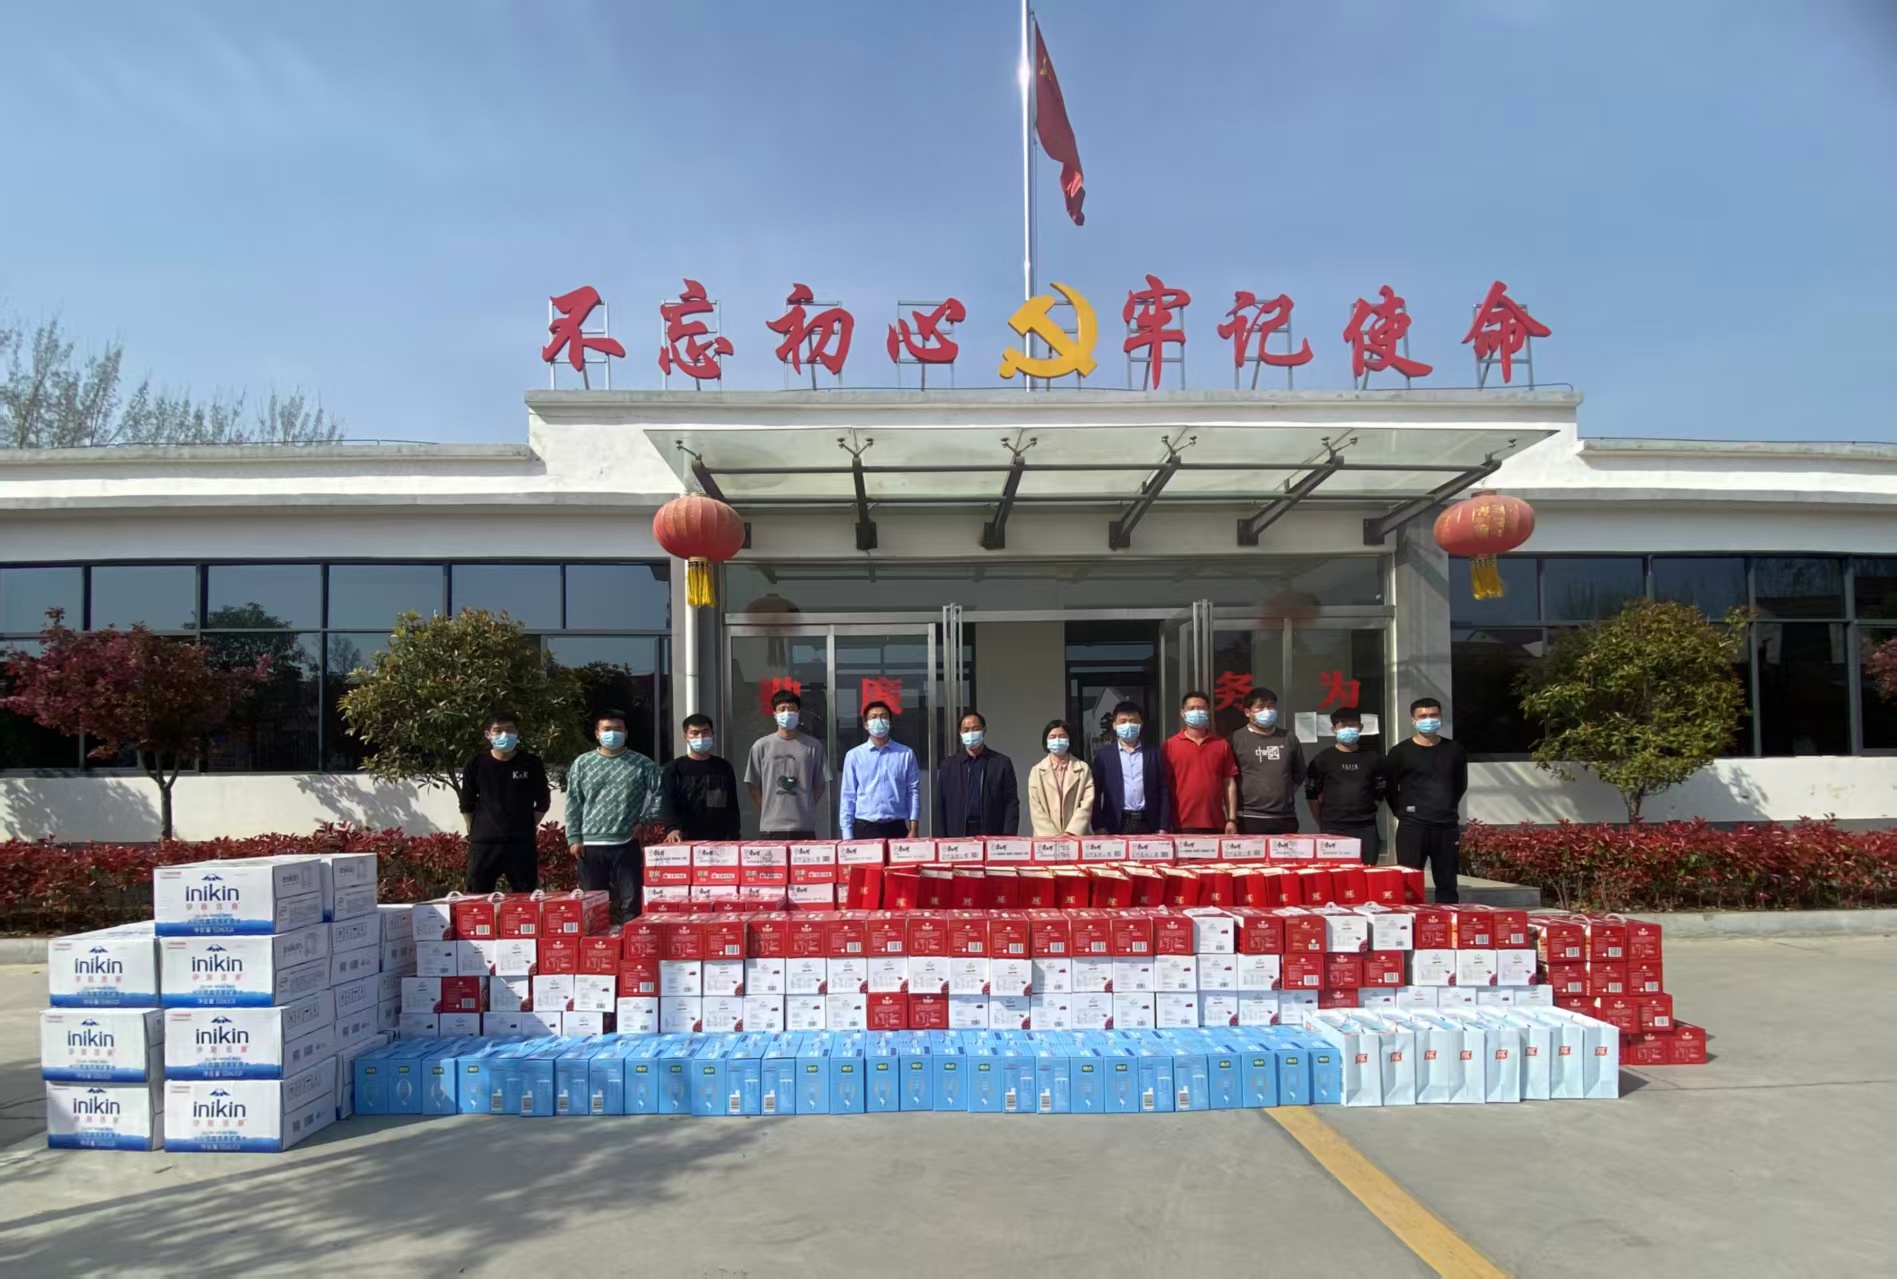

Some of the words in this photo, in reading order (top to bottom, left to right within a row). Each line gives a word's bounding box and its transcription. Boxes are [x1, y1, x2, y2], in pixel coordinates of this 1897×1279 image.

[542, 278, 966, 380] 不忘初心
[1122, 273, 1552, 390] 牢记使命
[186, 883, 240, 902] inikin
[75, 955, 123, 974] inikin
[192, 953, 243, 972] inikin
[67, 1028, 115, 1047] inikin
[196, 1025, 249, 1045] inikin
[73, 1094, 120, 1115] inikin
[193, 1099, 246, 1118] inikin
